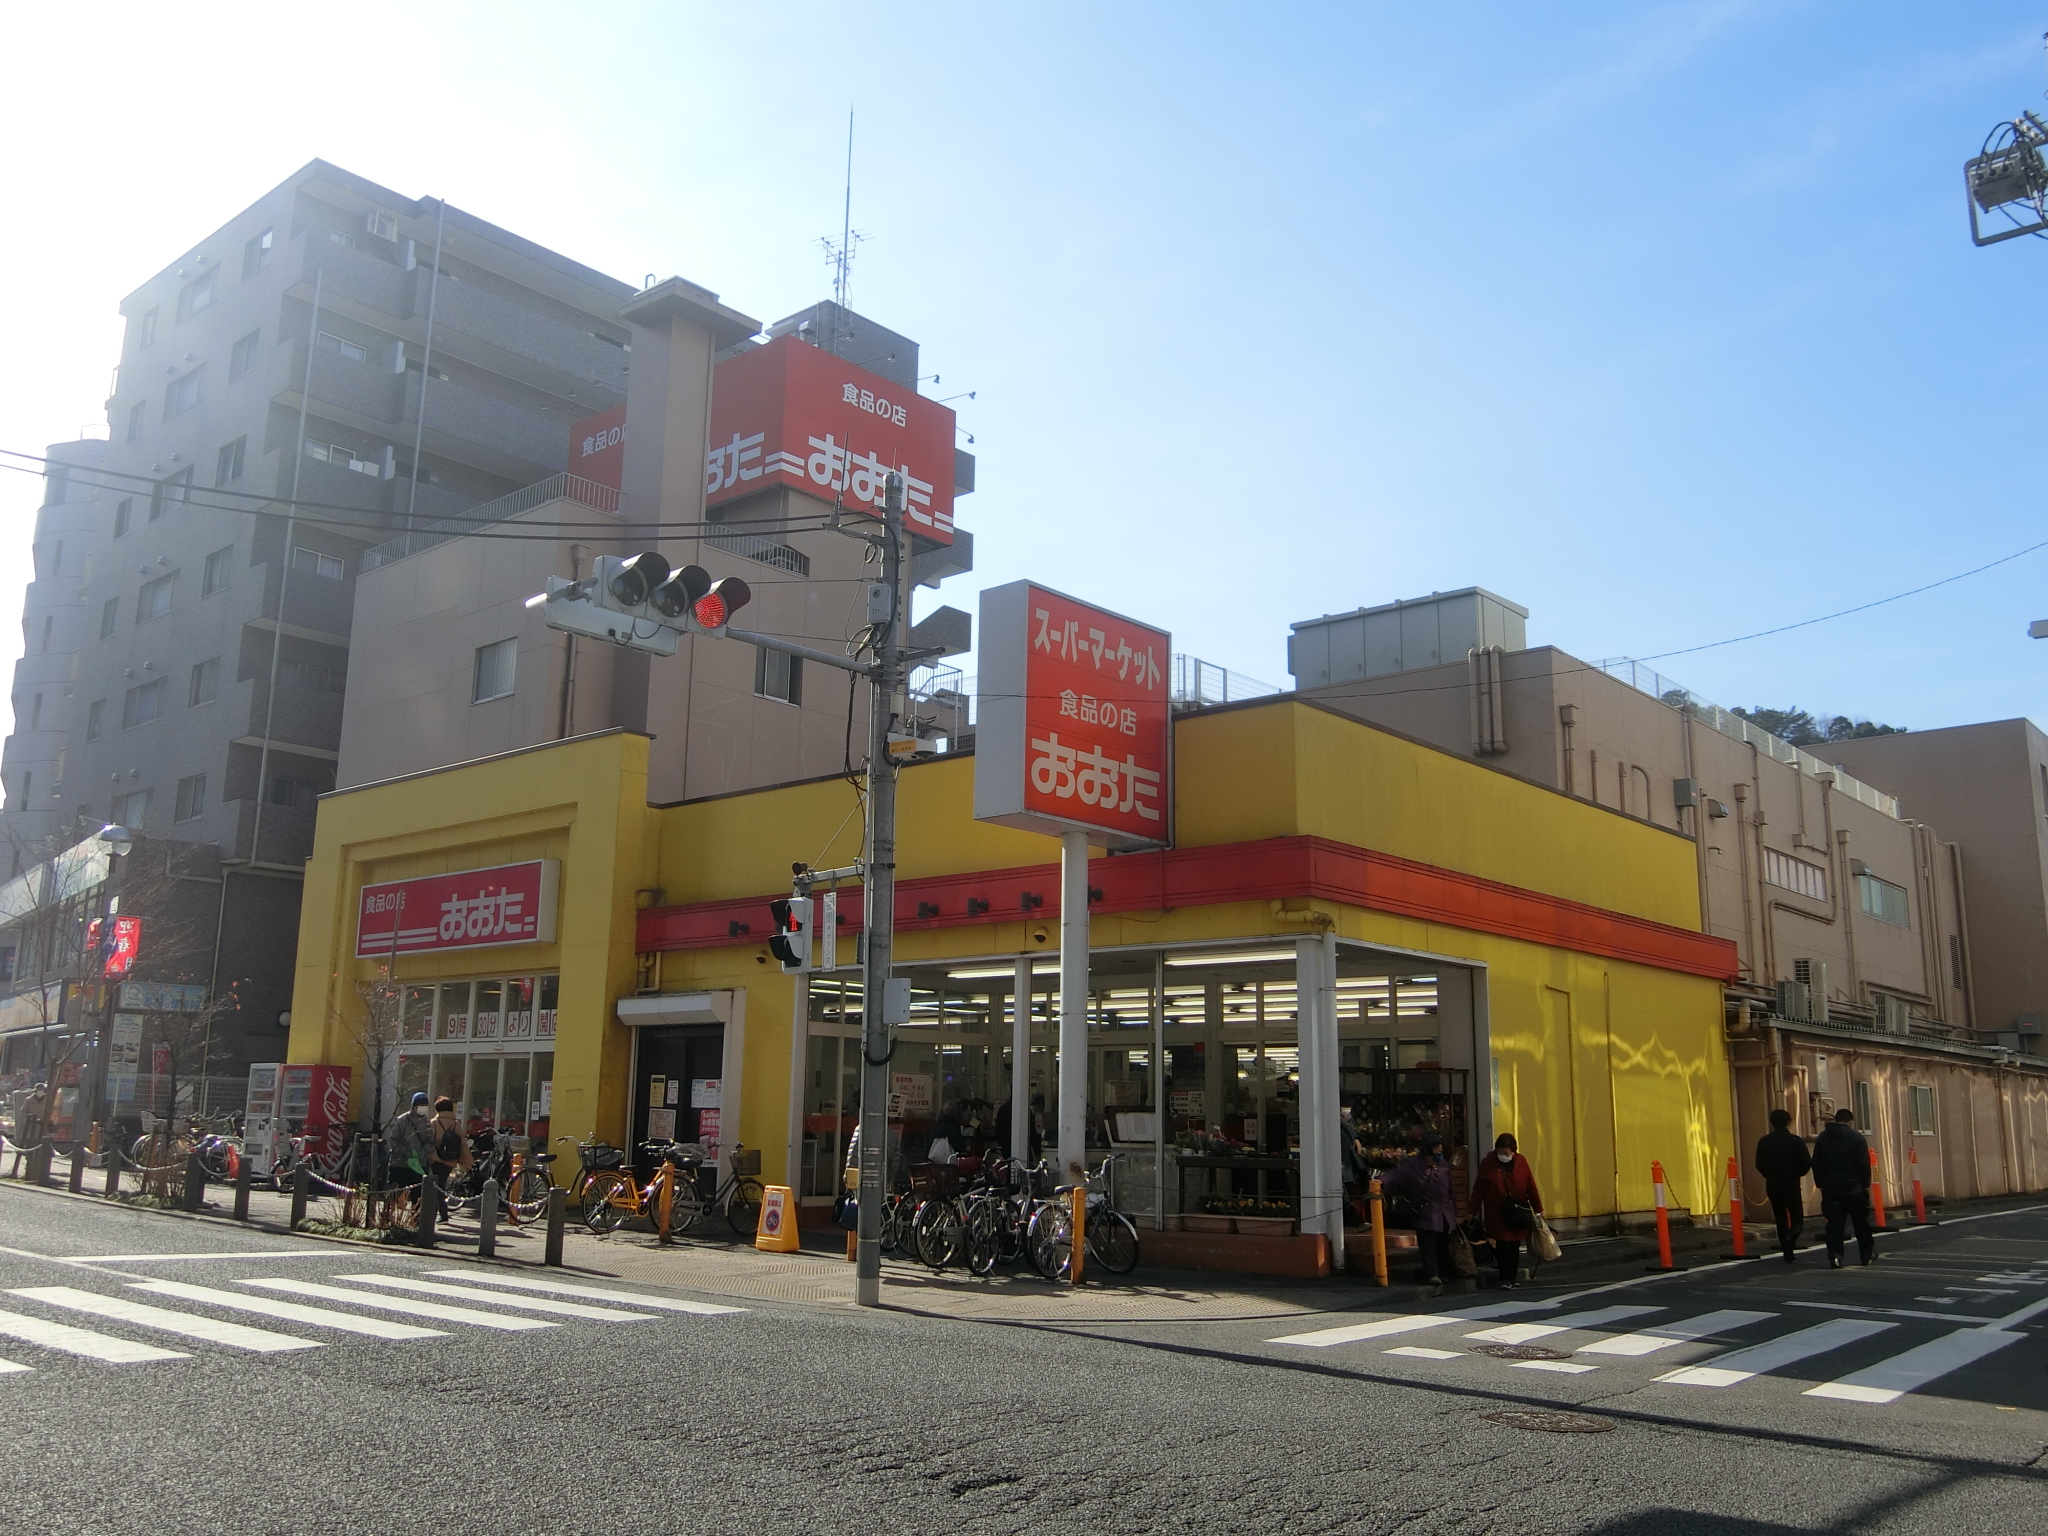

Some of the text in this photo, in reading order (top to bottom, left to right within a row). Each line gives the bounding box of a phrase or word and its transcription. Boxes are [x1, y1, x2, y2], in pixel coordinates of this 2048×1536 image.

[842, 382, 907, 428] 食品の店
[581, 423, 626, 458] 食品の
[807, 433, 934, 527] おおた
[1033, 607, 1161, 690] スーパーマーケット
[1059, 688, 1137, 736] 食品の店
[1031, 732, 1160, 821] おおた
[365, 891, 407, 914] 食品の店
[439, 886, 525, 941] おおた
[478, 1015, 498, 1035] 30分
[508, 1013, 530, 1032] より
